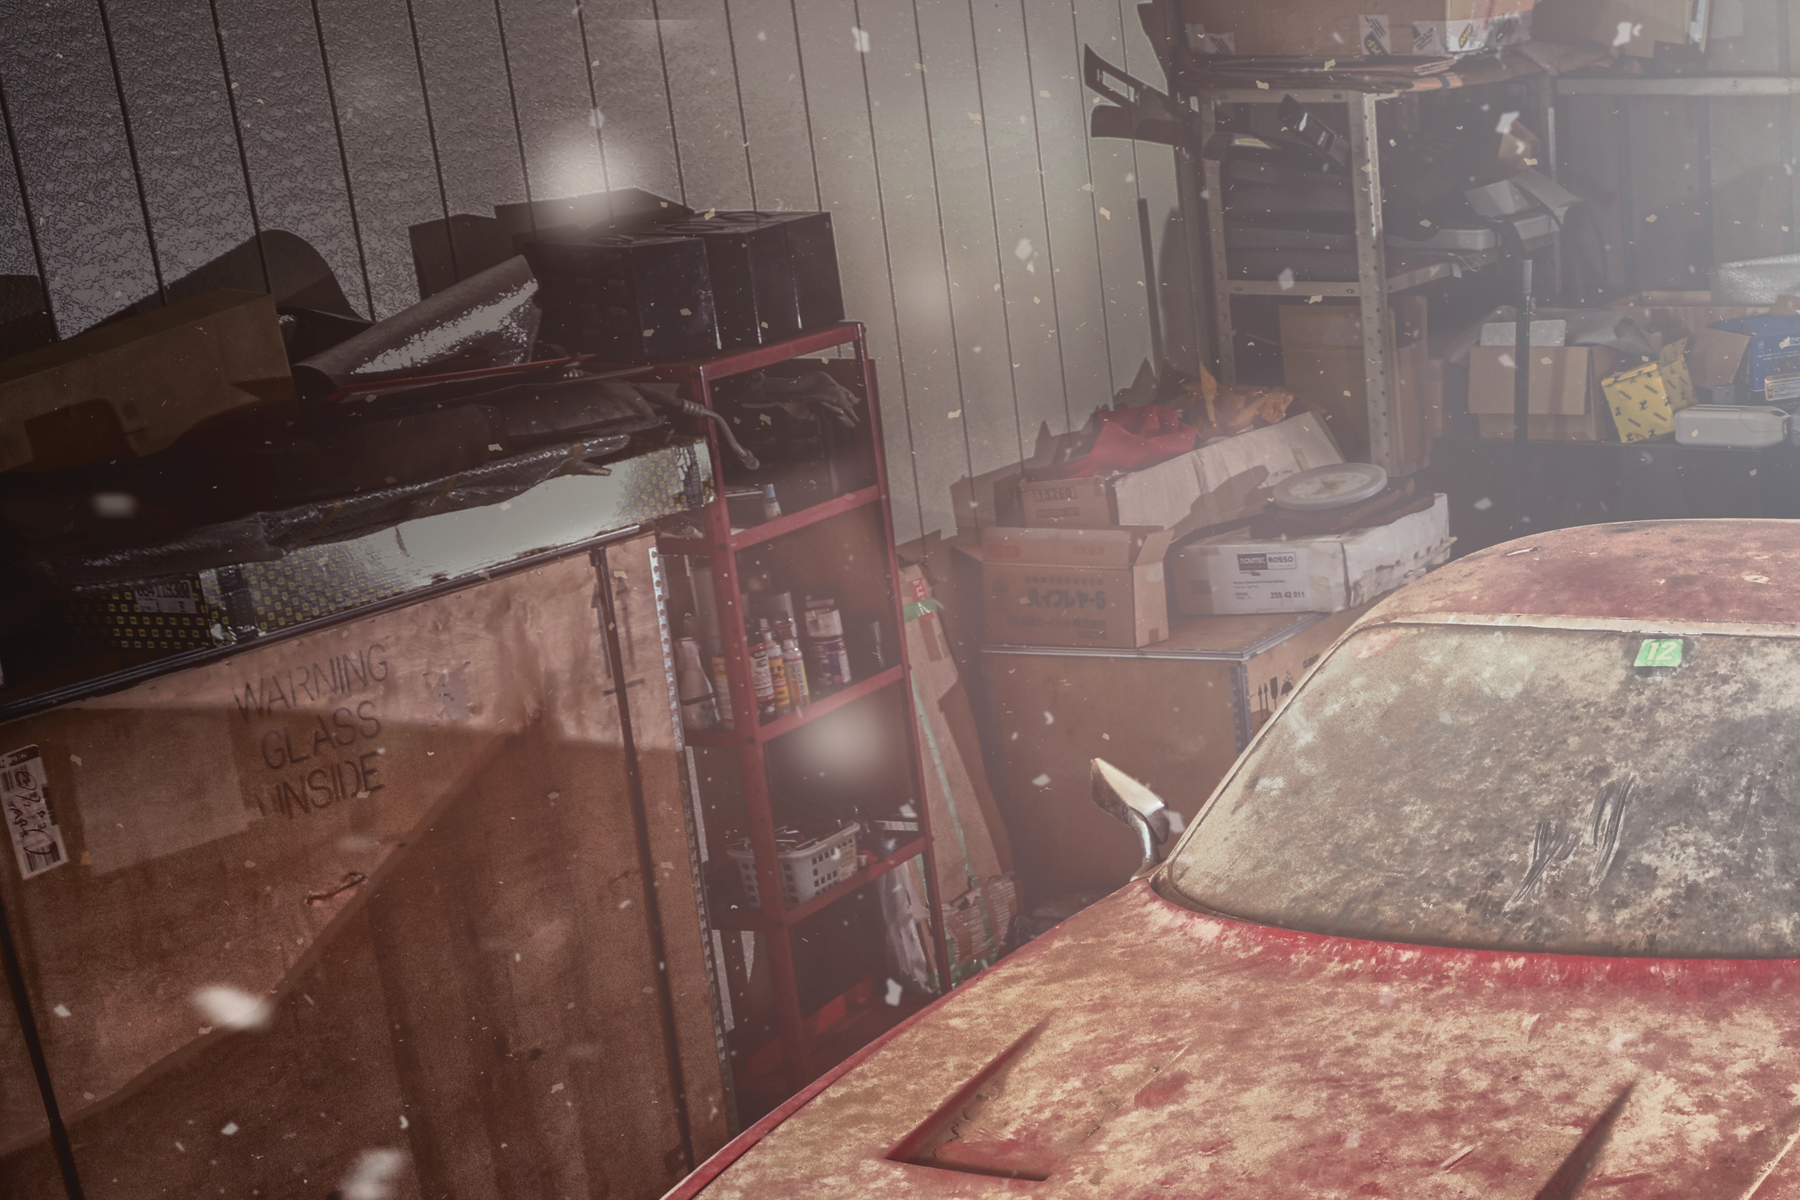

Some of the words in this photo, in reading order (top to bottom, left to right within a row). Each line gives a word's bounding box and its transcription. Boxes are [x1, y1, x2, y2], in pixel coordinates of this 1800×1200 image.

[1268, 556, 1294, 564] ROSSO
[231, 643, 388, 723] WARNING
[1646, 641, 1679, 661] 12
[261, 699, 382, 770] GLASS
[274, 748, 386, 820] INSIDE
